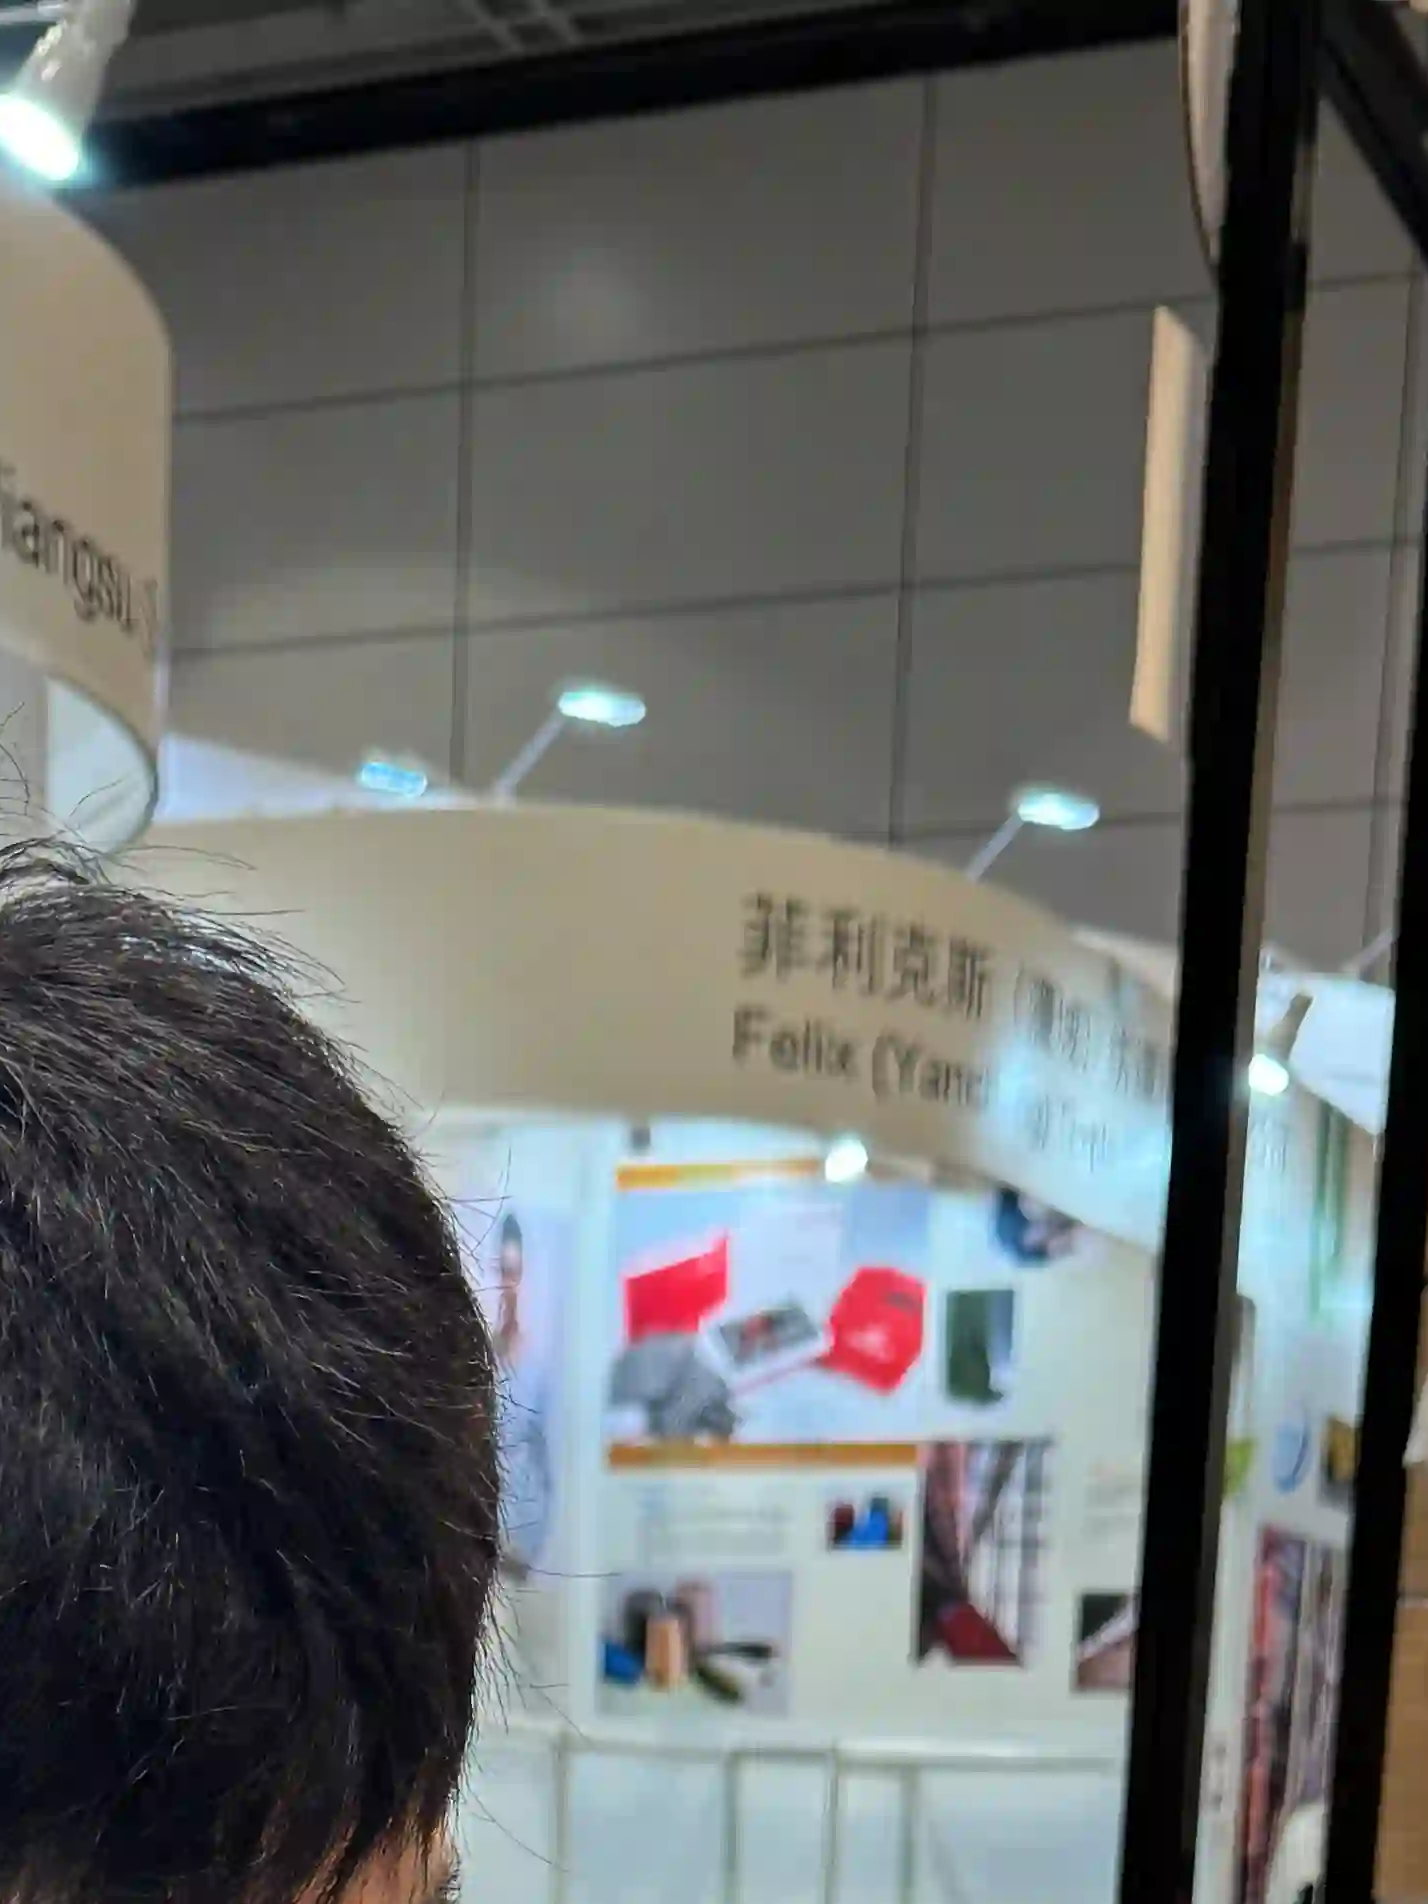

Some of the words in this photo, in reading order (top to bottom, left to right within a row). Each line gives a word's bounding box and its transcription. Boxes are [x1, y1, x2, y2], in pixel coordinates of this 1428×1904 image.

[738, 889, 991, 1021] 菲利克斯
[731, 1000, 857, 1078] Felix
